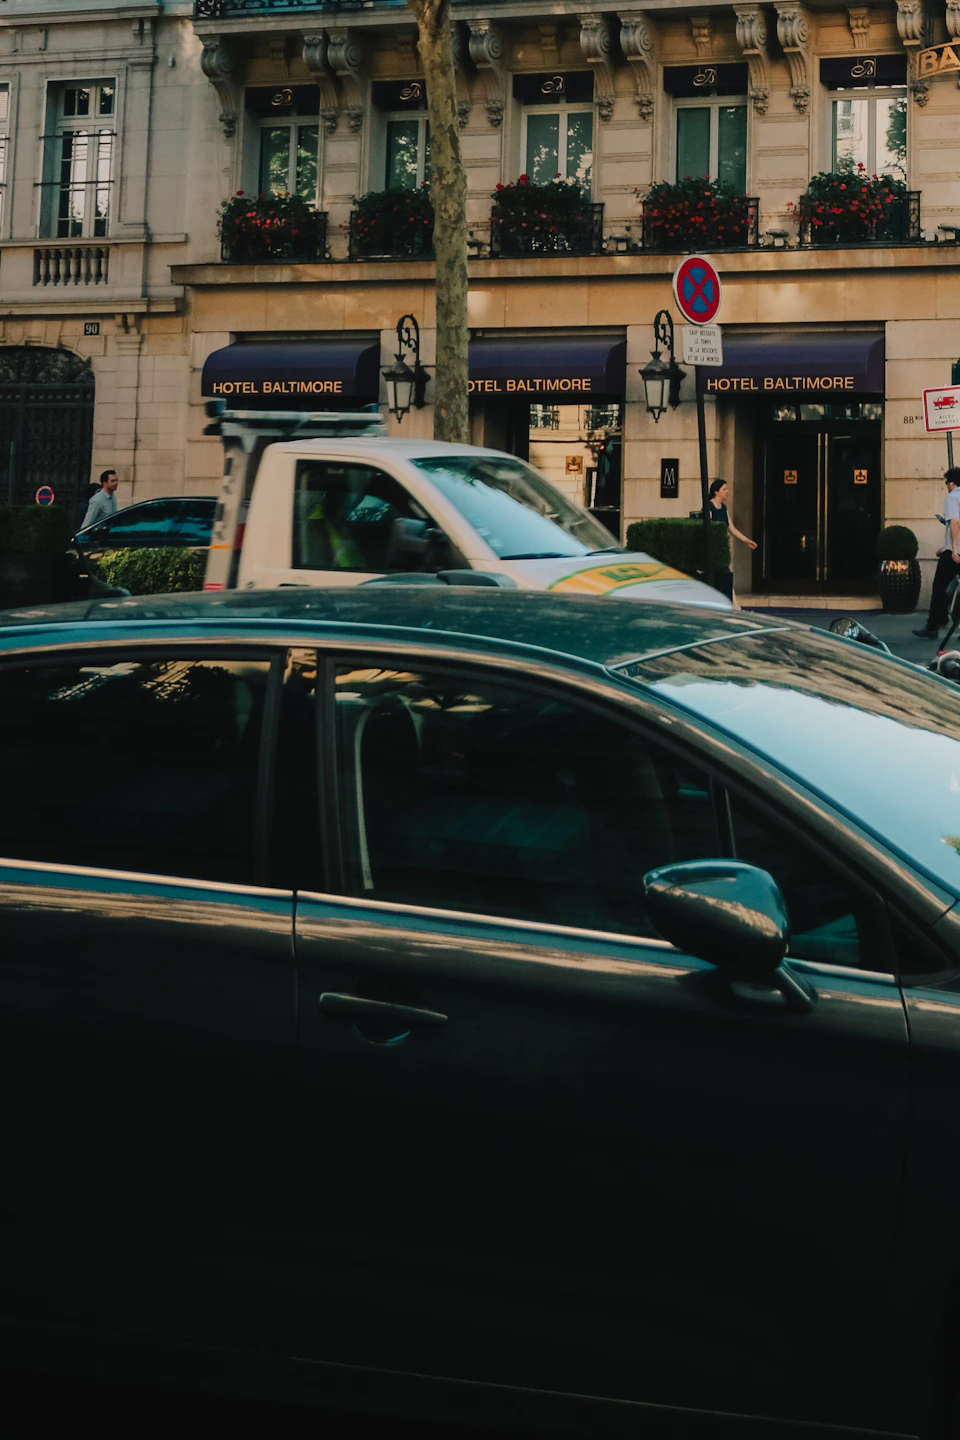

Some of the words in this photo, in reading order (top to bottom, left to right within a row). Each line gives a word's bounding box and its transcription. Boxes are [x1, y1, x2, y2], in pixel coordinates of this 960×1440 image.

[85, 323, 98, 334] 90
[213, 382, 258, 394] HOTEL
[263, 381, 342, 393] BALTIMORE
[468, 380, 502, 392] OTEL
[506, 378, 591, 392] BALTIMORE
[708, 378, 758, 390] HOTEL
[764, 377, 854, 390] BALTIMORE
[904, 416, 914, 424] 88
